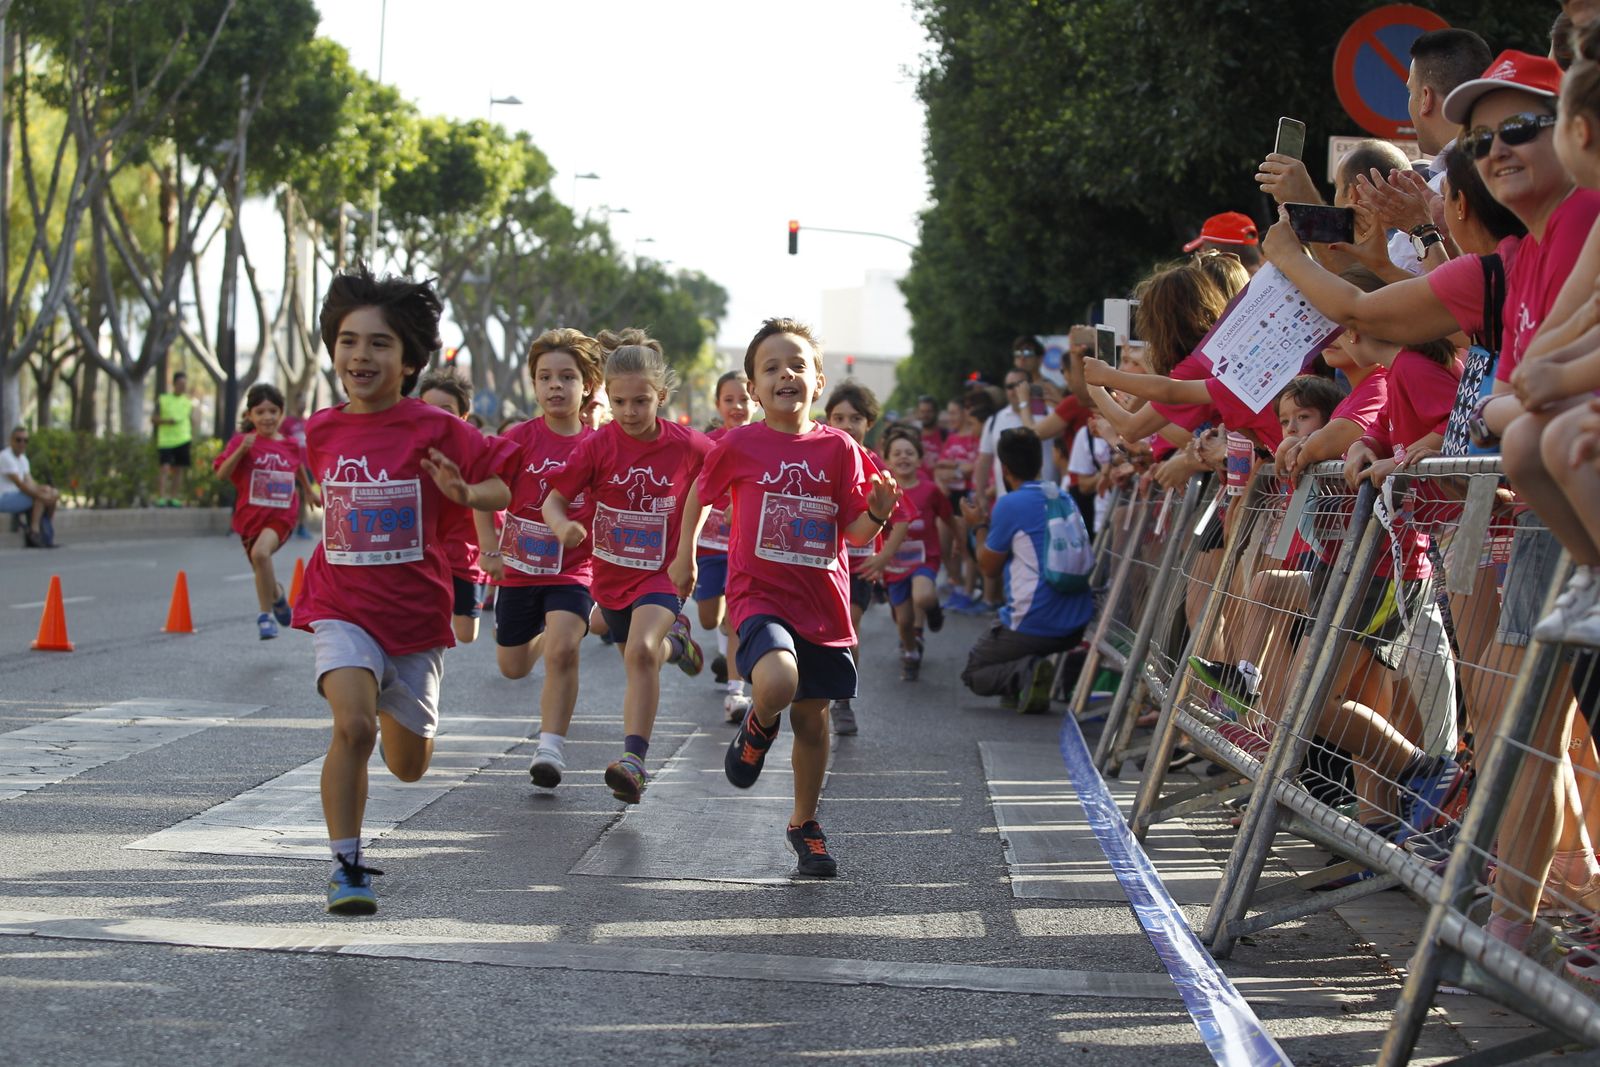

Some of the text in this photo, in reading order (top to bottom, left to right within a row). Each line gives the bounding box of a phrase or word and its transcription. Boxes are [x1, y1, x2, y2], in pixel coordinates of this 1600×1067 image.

[1222, 315, 1247, 341] CARRERA
[1245, 285, 1274, 315] SOLIDARIA
[347, 507, 415, 533] 1799
[612, 528, 662, 547] 1750
